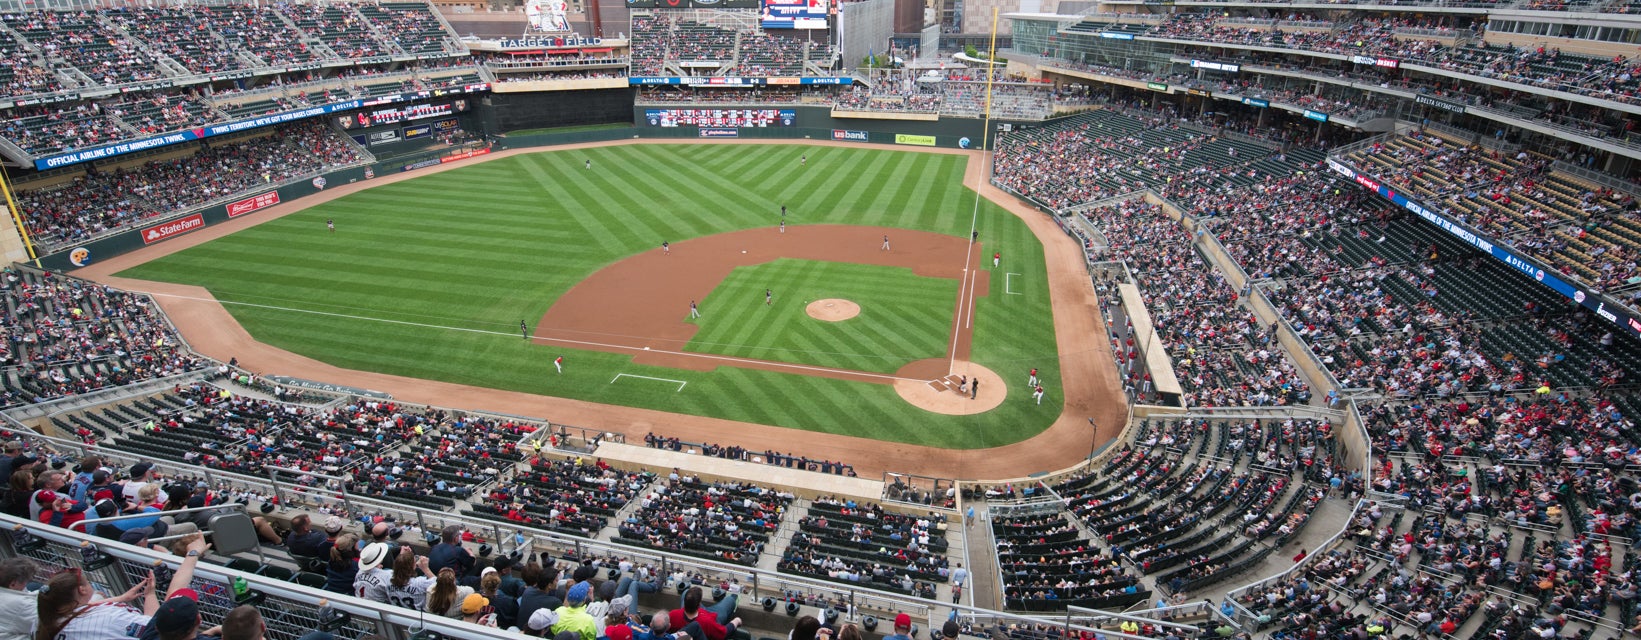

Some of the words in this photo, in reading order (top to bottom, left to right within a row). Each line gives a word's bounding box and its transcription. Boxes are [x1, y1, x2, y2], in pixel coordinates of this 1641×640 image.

[501, 39, 552, 48] TARGET
[566, 38, 601, 46] FIELD
[336, 102, 352, 110] DELTA
[1421, 96, 1435, 106] DELTA
[212, 125, 230, 134] TWINS
[256, 118, 271, 126] WE'VE
[271, 116, 280, 124] GOT
[281, 113, 293, 122] YOUR
[293, 110, 306, 120] BASES
[406, 128, 429, 137] SUBWAY
[47, 154, 79, 167] OFFICIAL
[80, 148, 105, 161] AIRLINE
[106, 146, 114, 156] OF
[115, 144, 128, 154] THE
[130, 138, 164, 150] MINNESOTA
[1406, 200, 1422, 216] OFFICIAL
[1422, 208, 1436, 223] AIRLINE
[1436, 216, 1442, 226] OF
[1442, 220, 1450, 231] THE
[1450, 224, 1476, 245] MINNESOTA
[1512, 257, 1534, 274] DELTA
[1597, 307, 1617, 323] DOZIER
[359, 586, 365, 598] 1
[388, 584, 417, 595] OREAU
